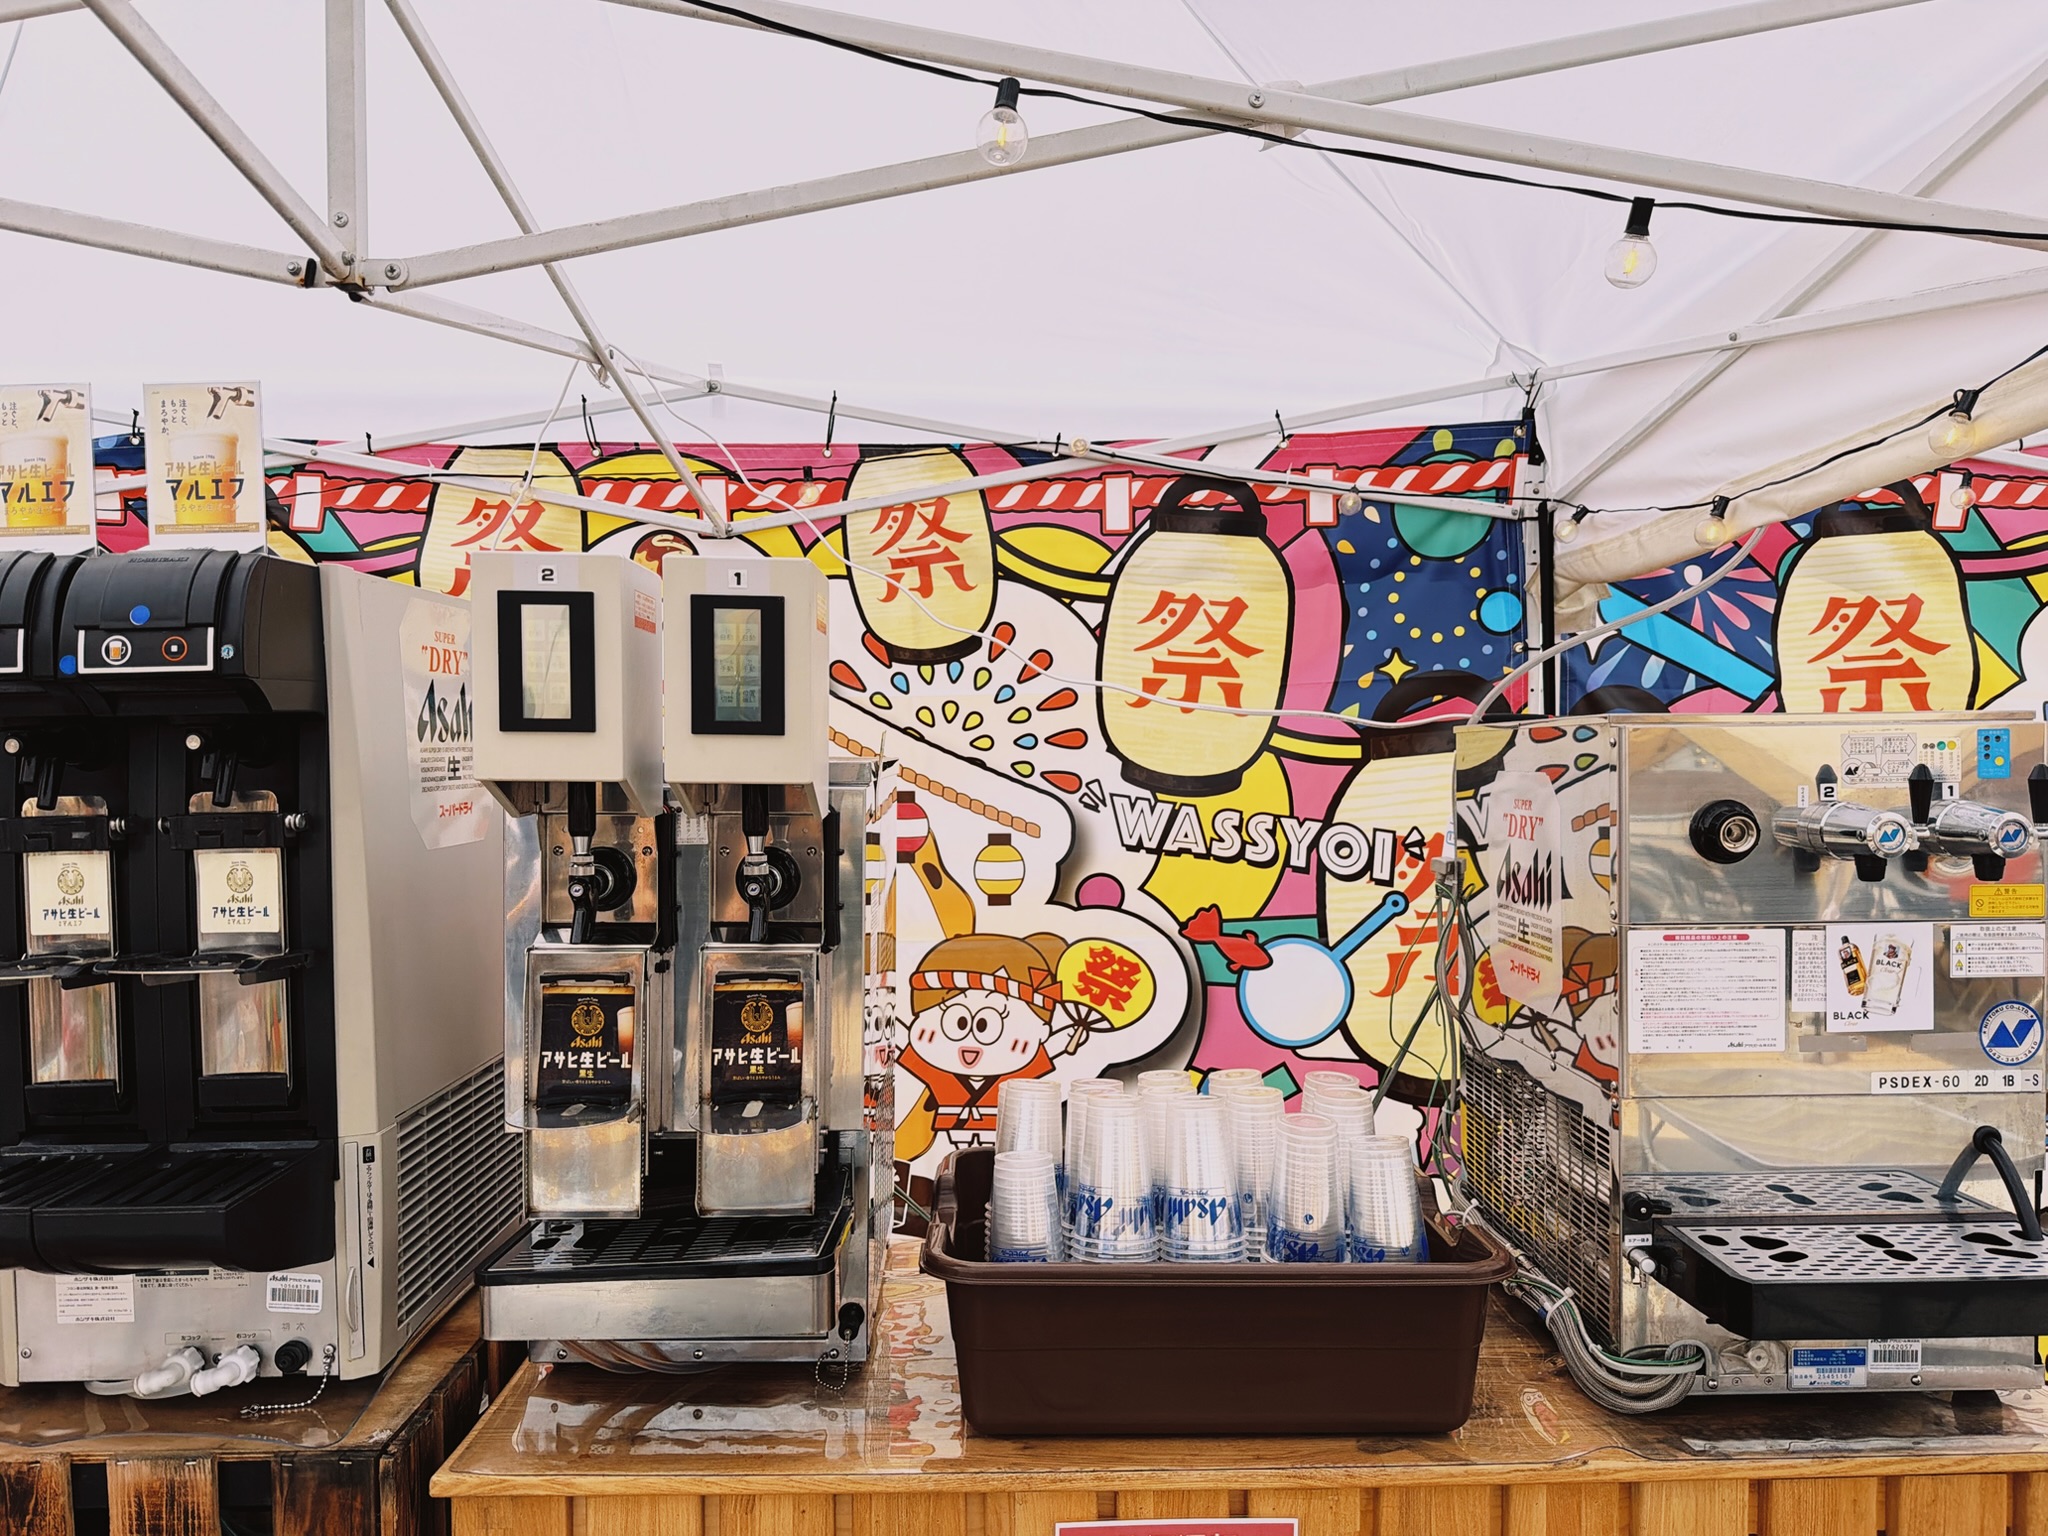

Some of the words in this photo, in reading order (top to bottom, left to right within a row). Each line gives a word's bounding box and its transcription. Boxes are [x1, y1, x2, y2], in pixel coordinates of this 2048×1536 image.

[165, 460, 245, 478] アサヒ生ビール
[0, 481, 75, 504] マルエフ
[165, 478, 245, 501] マルエフ
[869, 495, 977, 604] 祭
[541, 568, 555, 582] 2
[733, 571, 743, 586] 1
[434, 631, 456, 645] SUPER
[1125, 589, 1265, 717] 祭
[1807, 592, 1951, 712] 祭
[417, 678, 473, 743] Asah
[447, 755, 462, 781] 生
[1824, 786, 1835, 798] 2
[1947, 785, 1954, 797] 1
[439, 801, 474, 818] スーパードライ
[1513, 798, 1533, 811] SUPER
[1110, 793, 1397, 886] WASSYOI
[1496, 843, 1552, 914] Asahi
[58, 895, 84, 906] Asahi
[227, 893, 253, 904] Asahi
[42, 907, 101, 921] アサヒ生ビール
[212, 905, 270, 919] アサヒ生ビール
[1517, 918, 1531, 944] 生
[1510, 959, 1541, 983] スーパードライ
[1876, 959, 1903, 969] BLACK
[1072, 946, 1142, 1012] 祭
[1833, 1011, 1870, 1020] BLACK
[1984, 1006, 2004, 1029] NITTOKU
[570, 1035, 603, 1049] Asahi
[740, 1031, 773, 1045] Asahi
[541, 1051, 632, 1069] アサヒ生ビール
[712, 1046, 802, 1066] アサヒ生ビール
[1988, 1041, 2038, 1062] 042-345-3410
[579, 1069, 594, 1078] 黒生
[749, 1065, 765, 1075] 黒生
[1879, 1075, 1961, 1089] PSDEX-60
[1974, 1075, 1989, 1087] 2D
[2002, 1075, 2015, 1087] 1B
[1168, 1196, 1228, 1227] Asahi
[269, 1274, 289, 1282] Asahi
